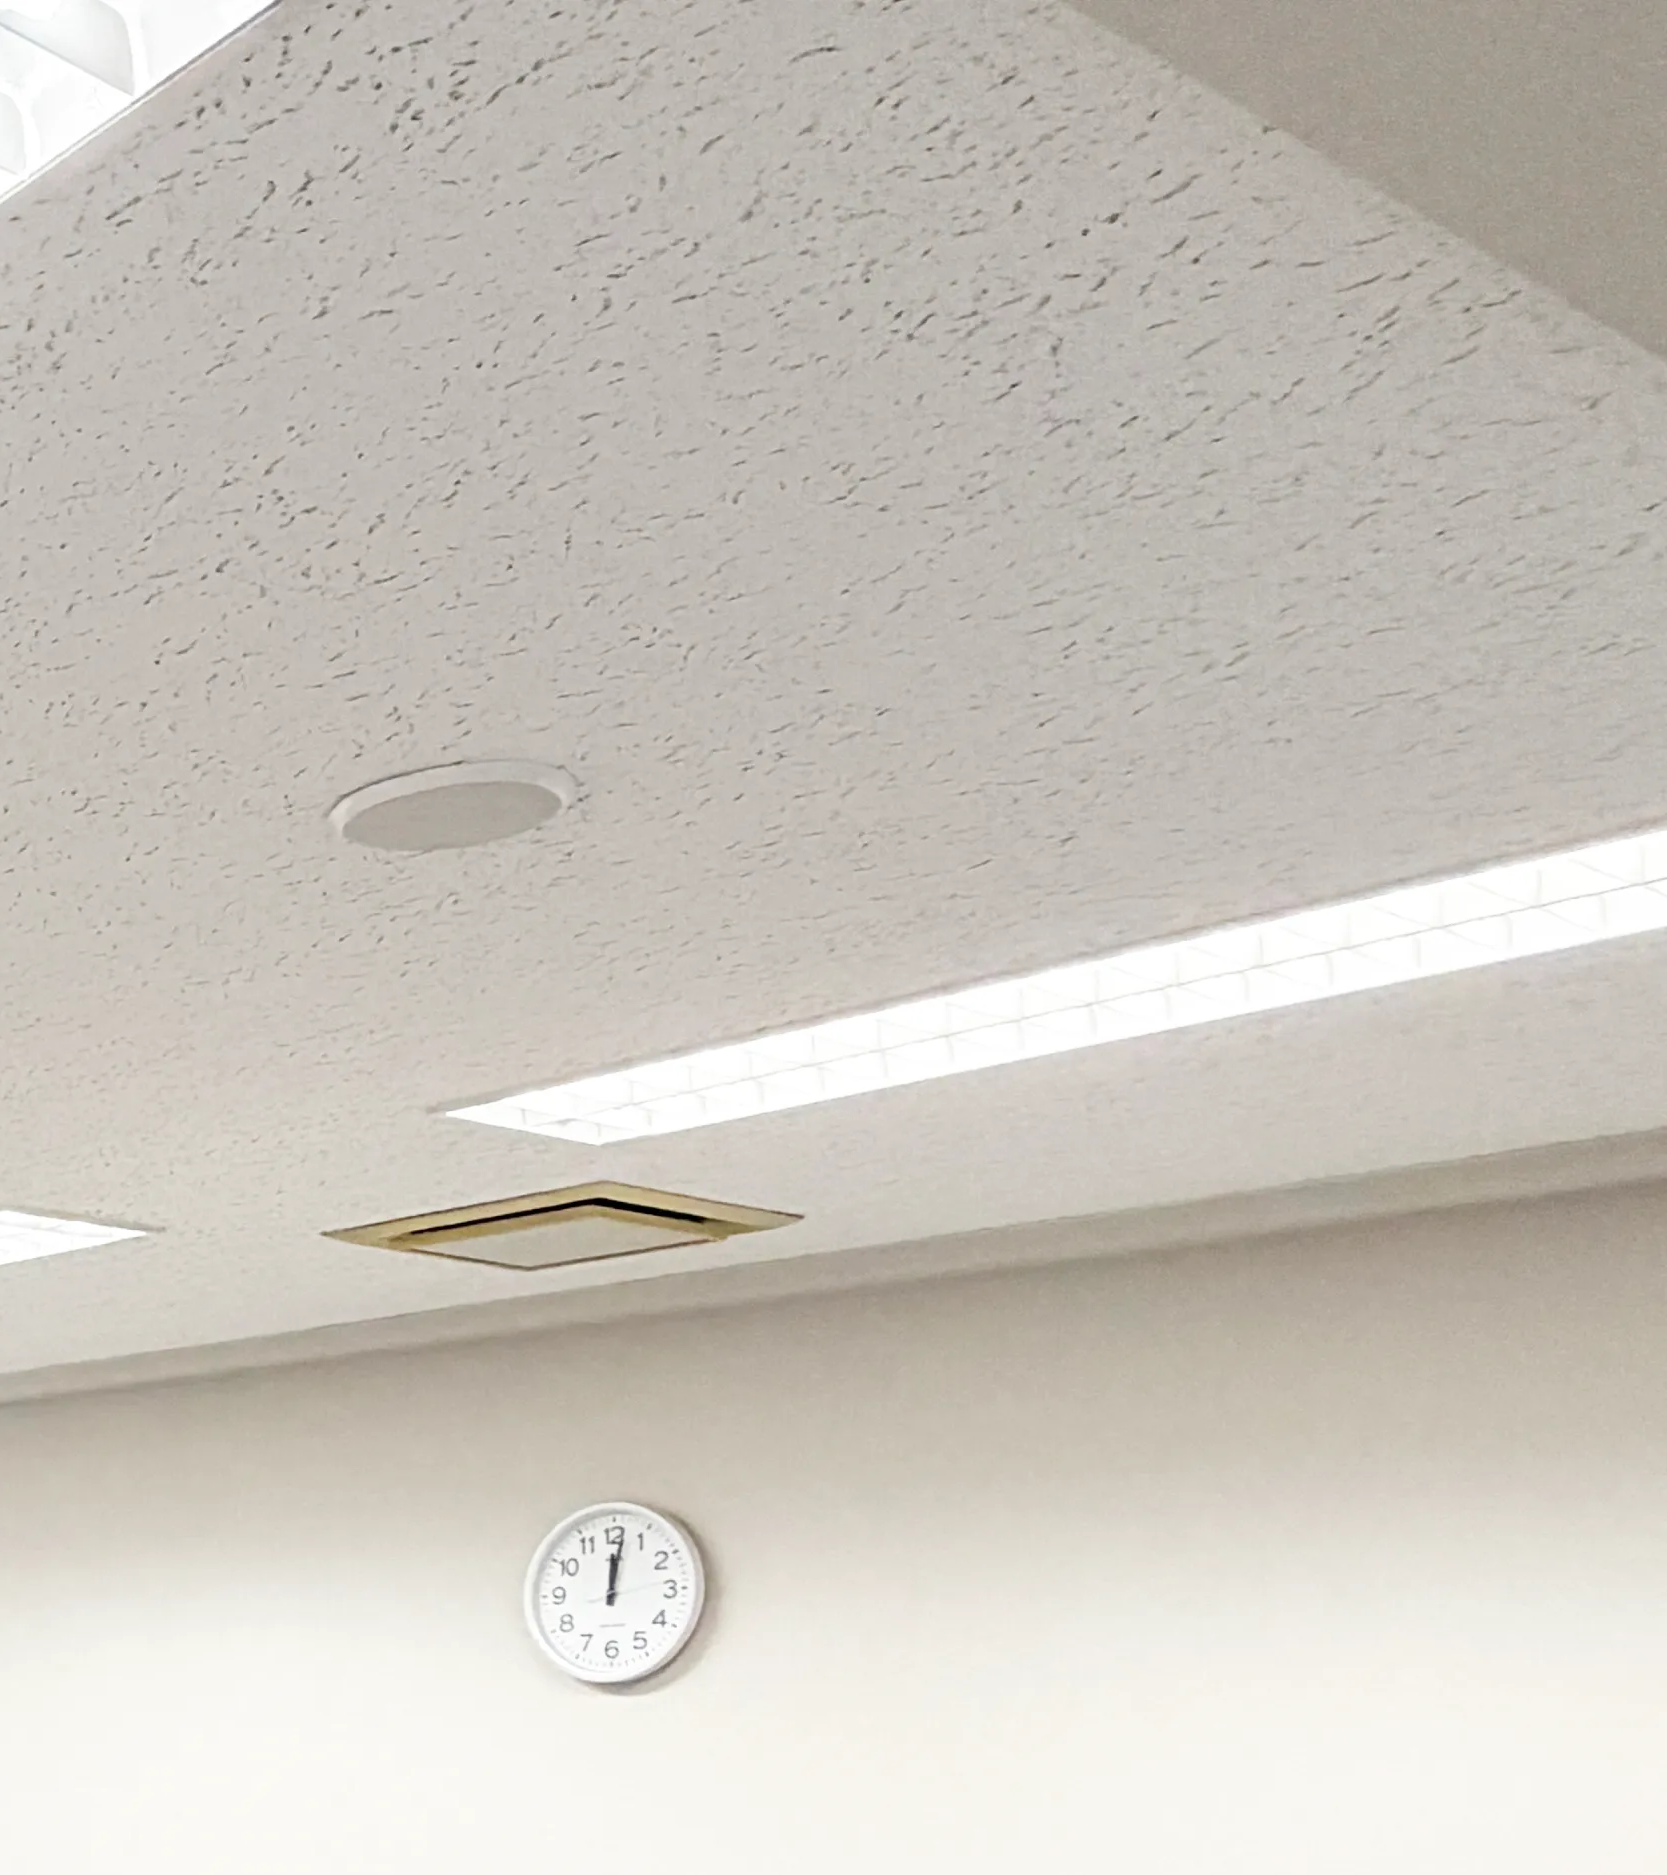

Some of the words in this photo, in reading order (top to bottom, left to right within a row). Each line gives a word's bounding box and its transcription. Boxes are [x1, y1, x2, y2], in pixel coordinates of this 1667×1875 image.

[604, 1525, 625, 1545] 12
[637, 1532, 644, 1551] 1
[580, 1536, 595, 1555] 11
[560, 1557, 580, 1577] 10
[654, 1551, 669, 1570] 2
[552, 1586, 567, 1605] 9
[663, 1579, 678, 1599] 3
[559, 1613, 574, 1633] 8
[652, 1609, 667, 1628] 4
[580, 1633, 594, 1652] 7
[604, 1640, 620, 1659] 6
[633, 1630, 648, 1650] 5
